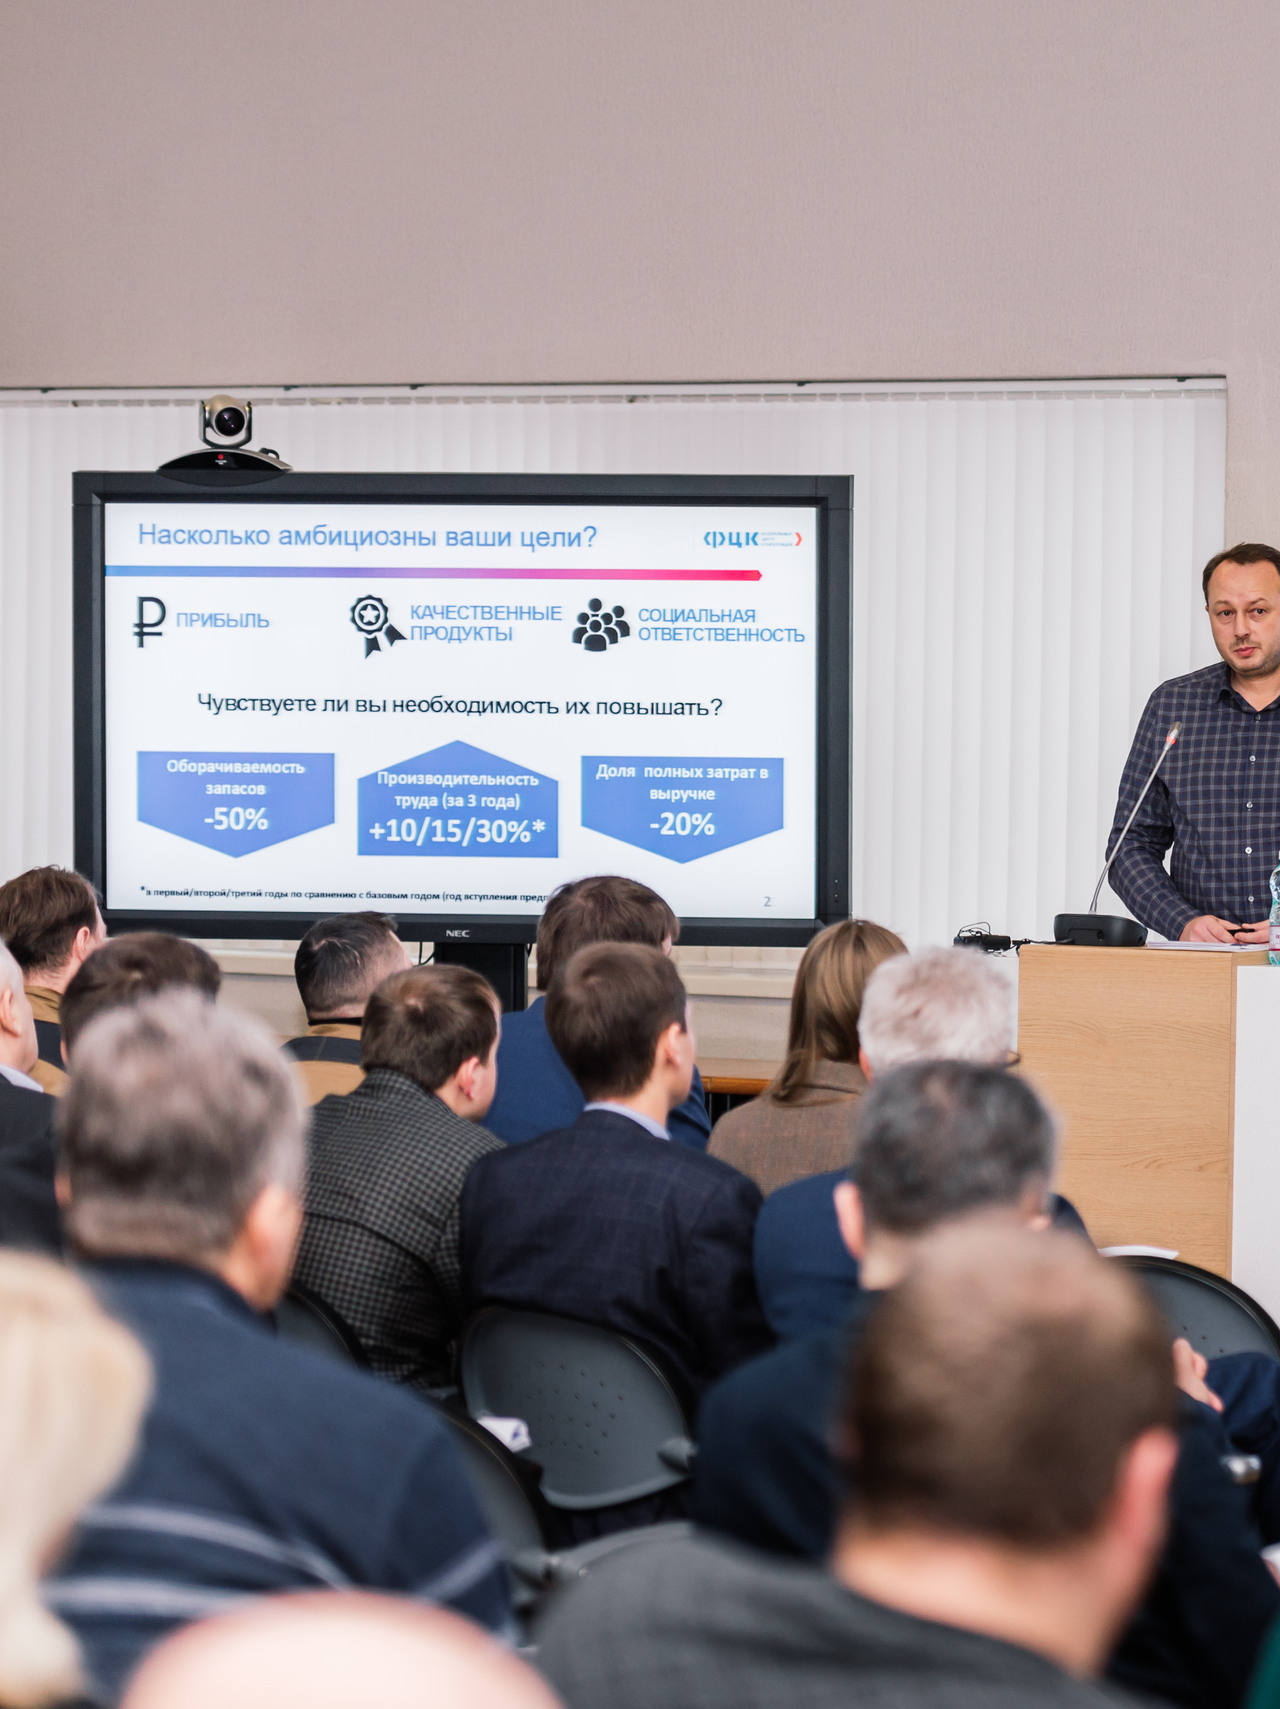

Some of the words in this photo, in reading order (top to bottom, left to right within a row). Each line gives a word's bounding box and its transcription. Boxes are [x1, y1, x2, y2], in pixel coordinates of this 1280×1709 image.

[139, 523, 270, 545] Насколько
[279, 524, 436, 551] амбициозны
[446, 531, 511, 546] ваши
[521, 526, 597, 552] цели?
[704, 531, 758, 548] ФЦК
[177, 613, 269, 628] ПРИБЫЛЬ
[411, 605, 562, 620] КАЧЕСТВЕННЫЕ
[639, 609, 755, 624] СОЦИАЛЬНАЯ
[411, 626, 512, 643] ПРОДУКТЫ
[639, 627, 805, 642] ОТВЕТСТВЕННОСТЬ
[198, 694, 316, 716] Чувствуете
[321, 699, 349, 713] ли
[355, 699, 387, 713] вы
[393, 695, 559, 716] необходимость
[565, 701, 591, 715] их
[597, 699, 722, 715] повышать?
[167, 759, 305, 775] Оборачиваемость
[596, 764, 635, 780] Доля
[643, 766, 704, 779] полных
[707, 768, 756, 781] затрат
[759, 768, 769, 779] в
[376, 771, 540, 789] Производительность
[205, 783, 267, 796] запасов
[650, 789, 715, 803] выручке
[394, 796, 438, 809] труда
[442, 793, 464, 809] (за
[467, 794, 476, 807] 3
[481, 793, 520, 810] года)
[204, 807, 268, 830] -50%
[650, 812, 715, 835] -20%
[153, 888, 263, 899] первый/второй/третий
[264, 891, 289, 900] годы
[304, 892, 357, 900] сравнению
[365, 891, 409, 900] базовым
[410, 893, 441, 902] годом
[442, 891, 463, 903] (год
[463, 894, 518, 903] вступления
[763, 895, 772, 908] 2
[445, 929, 470, 938] NEC
